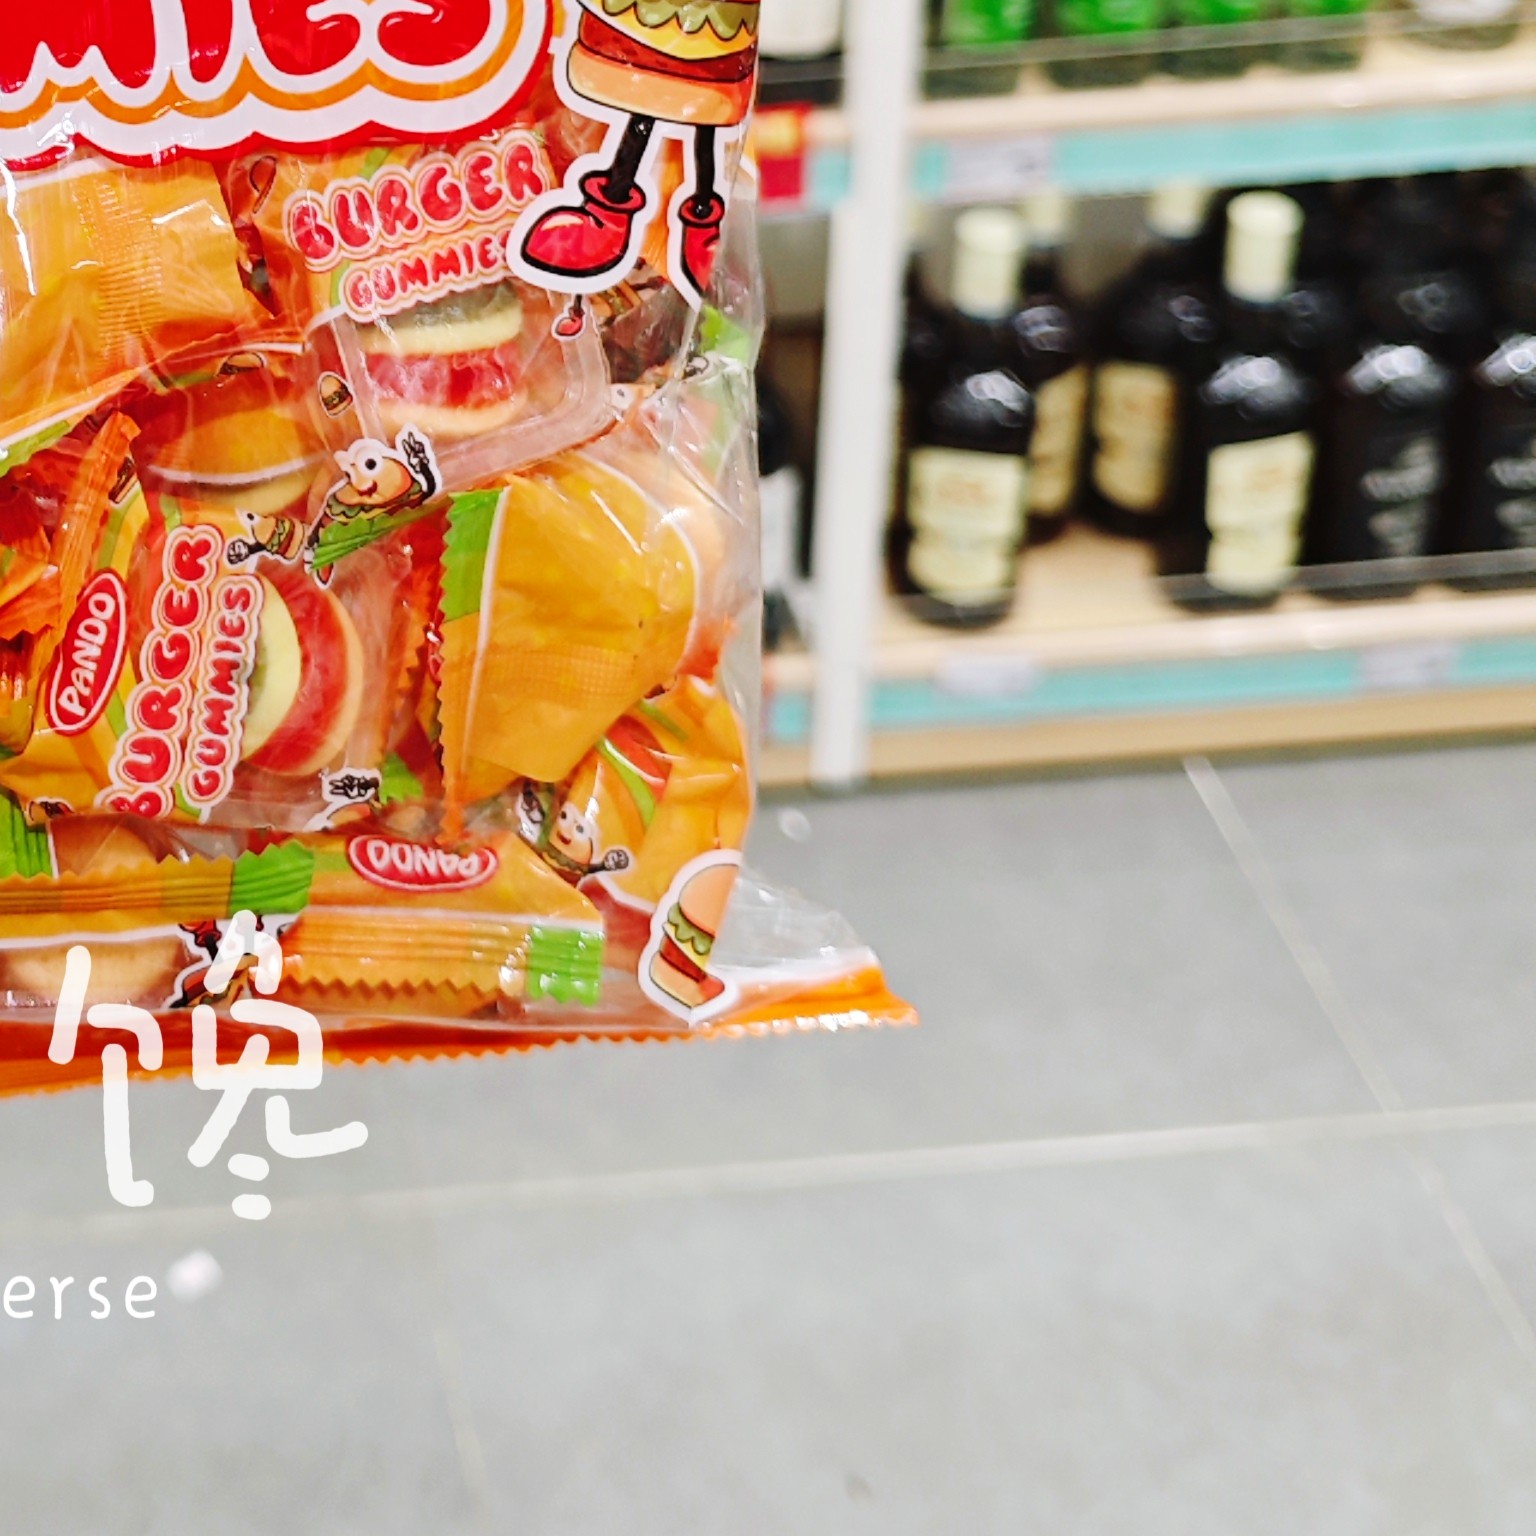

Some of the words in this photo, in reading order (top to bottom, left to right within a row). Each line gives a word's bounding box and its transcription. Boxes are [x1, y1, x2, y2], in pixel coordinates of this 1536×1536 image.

[290, 141, 545, 262] BURGER
[57, 590, 117, 718] PANDO
[191, 584, 252, 798] GUMMIES
